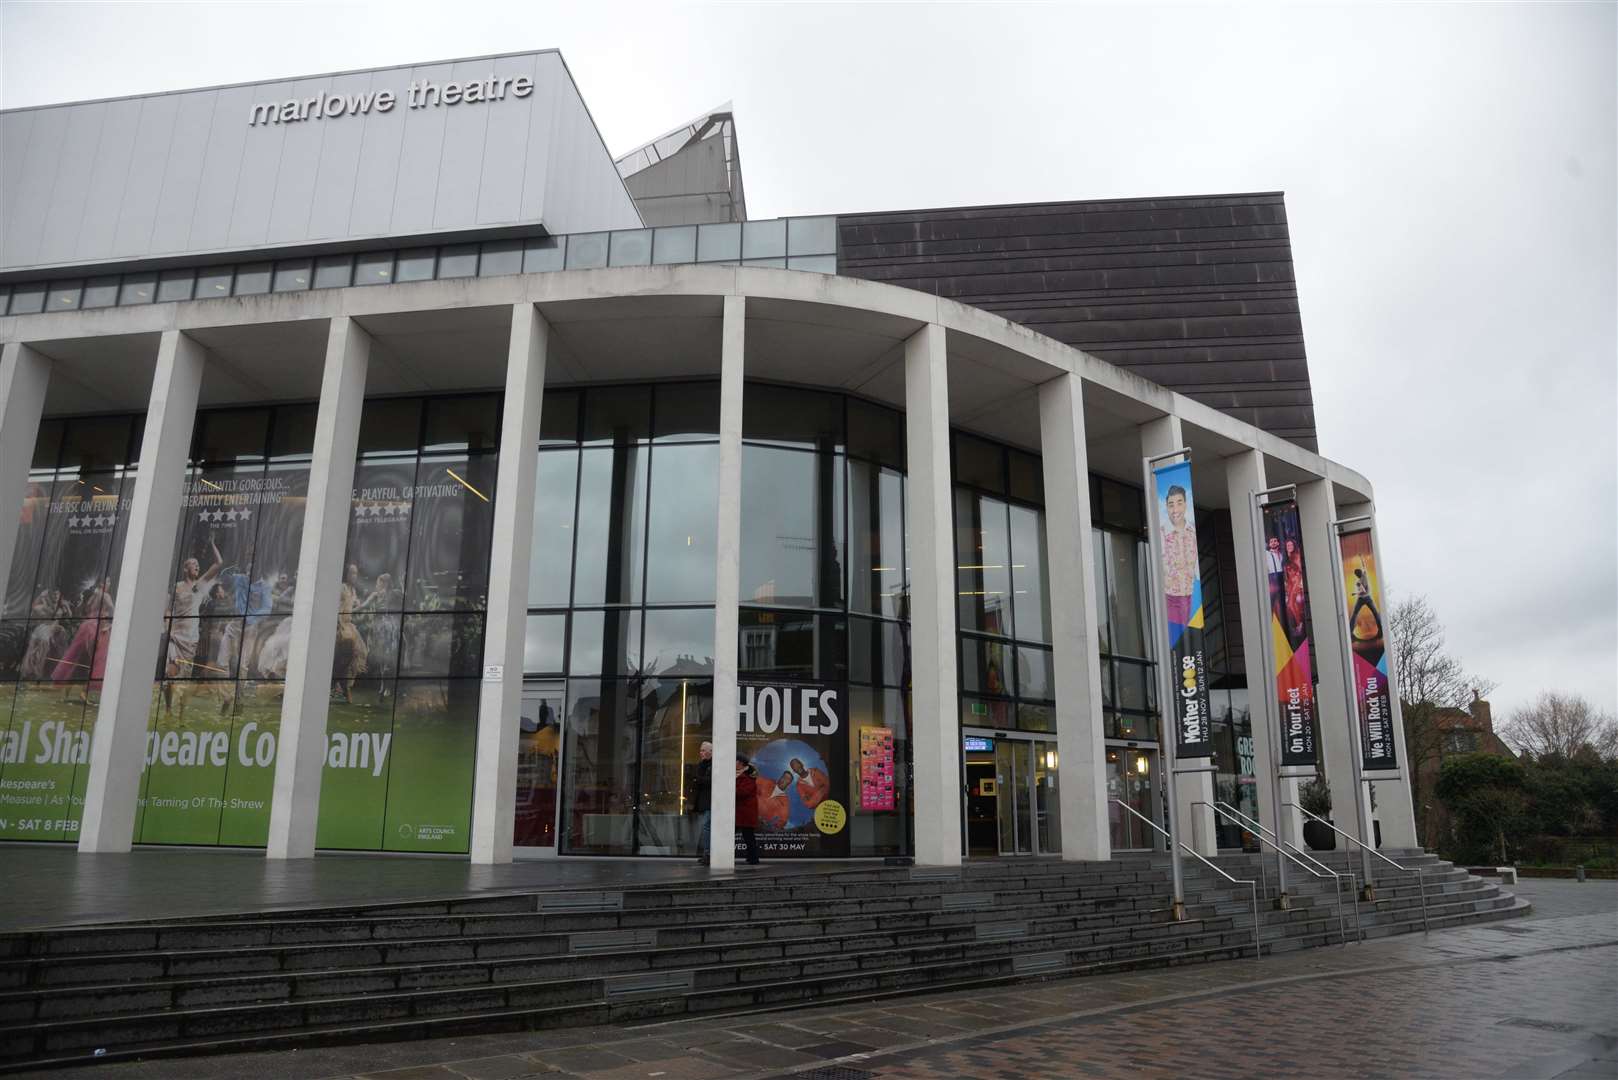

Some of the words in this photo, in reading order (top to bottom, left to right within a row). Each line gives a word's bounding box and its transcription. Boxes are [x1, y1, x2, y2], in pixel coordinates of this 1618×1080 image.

[249, 87, 395, 127] marlowe
[408, 73, 534, 108] theatre
[183, 494, 224, 507] BERANTLY
[1195, 650, 1203, 666] JAN
[1181, 655, 1197, 697] Goose
[1197, 667, 1204, 675] 12
[1365, 677, 1378, 695] You
[1199, 698, 1207, 715] NOV
[1286, 687, 1301, 710] Feet
[736, 686, 839, 735] HOLES
[1366, 697, 1381, 720] Rock
[1183, 699, 1201, 744] Mother
[1289, 711, 1303, 736] Your
[1368, 722, 1383, 741] Will
[1238, 736, 1256, 756] GRE
[1290, 738, 1304, 753] On
[1305, 736, 1313, 752] MON
[1371, 742, 1385, 758] We
[1, 793, 42, 805] Measure
[50, 795, 64, 805] As
[151, 797, 189, 809] Taming
[191, 797, 205, 807] Of
[207, 797, 228, 808] The
[230, 798, 264, 809] Shrew
[17, 819, 43, 831] SAT
[44, 819, 52, 831] 8
[54, 820, 80, 831] FEB
[764, 843, 778, 851] SAT
[779, 843, 788, 851] 30
[789, 843, 806, 851] MAY
